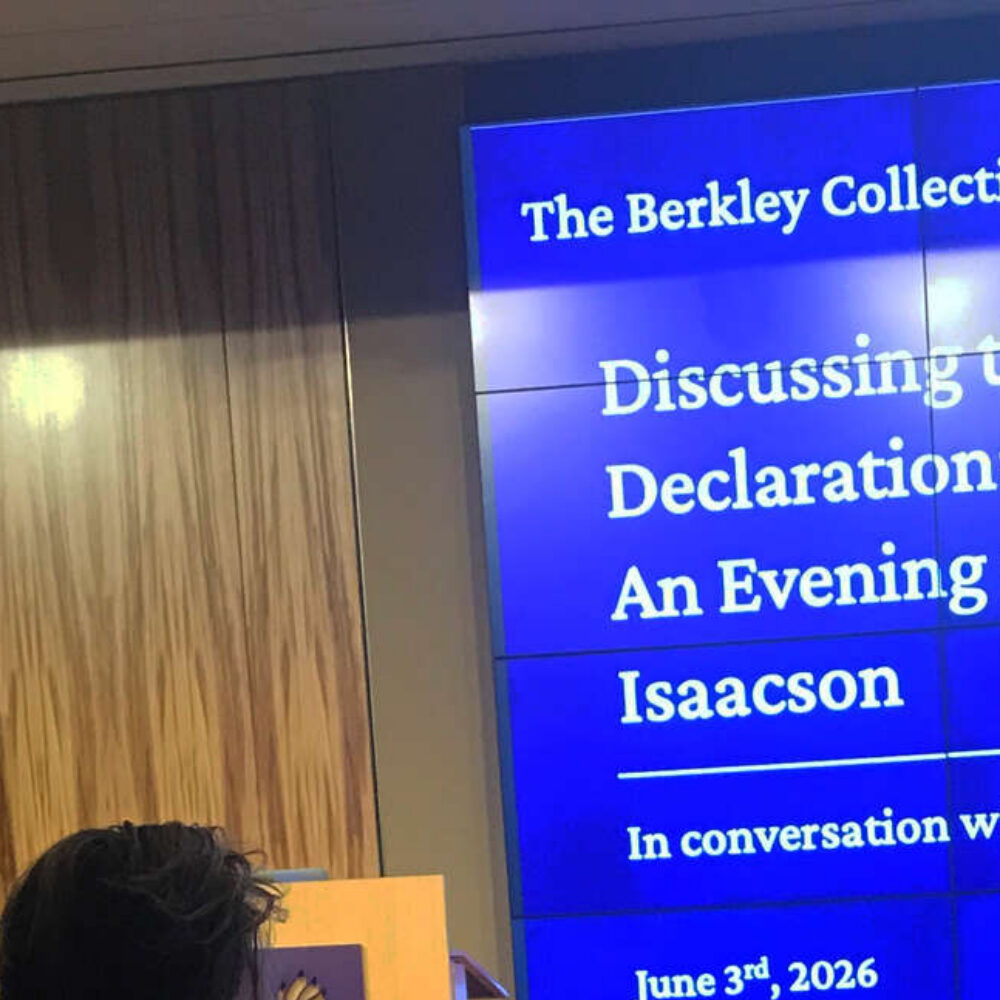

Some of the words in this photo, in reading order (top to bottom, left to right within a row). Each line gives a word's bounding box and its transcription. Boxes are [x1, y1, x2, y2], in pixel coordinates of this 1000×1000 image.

[520, 193, 614, 242] The
[625, 177, 810, 235] Berkley
[599, 333, 964, 416] Discussing
[610, 565, 704, 621] An
[717, 541, 988, 616] Evening
[618, 664, 905, 724] Isaacson
[626, 826, 672, 860] In
[681, 807, 951, 857] conversation
[723, 956, 782, 1000] 3rd,
[788, 957, 879, 992] 2026
